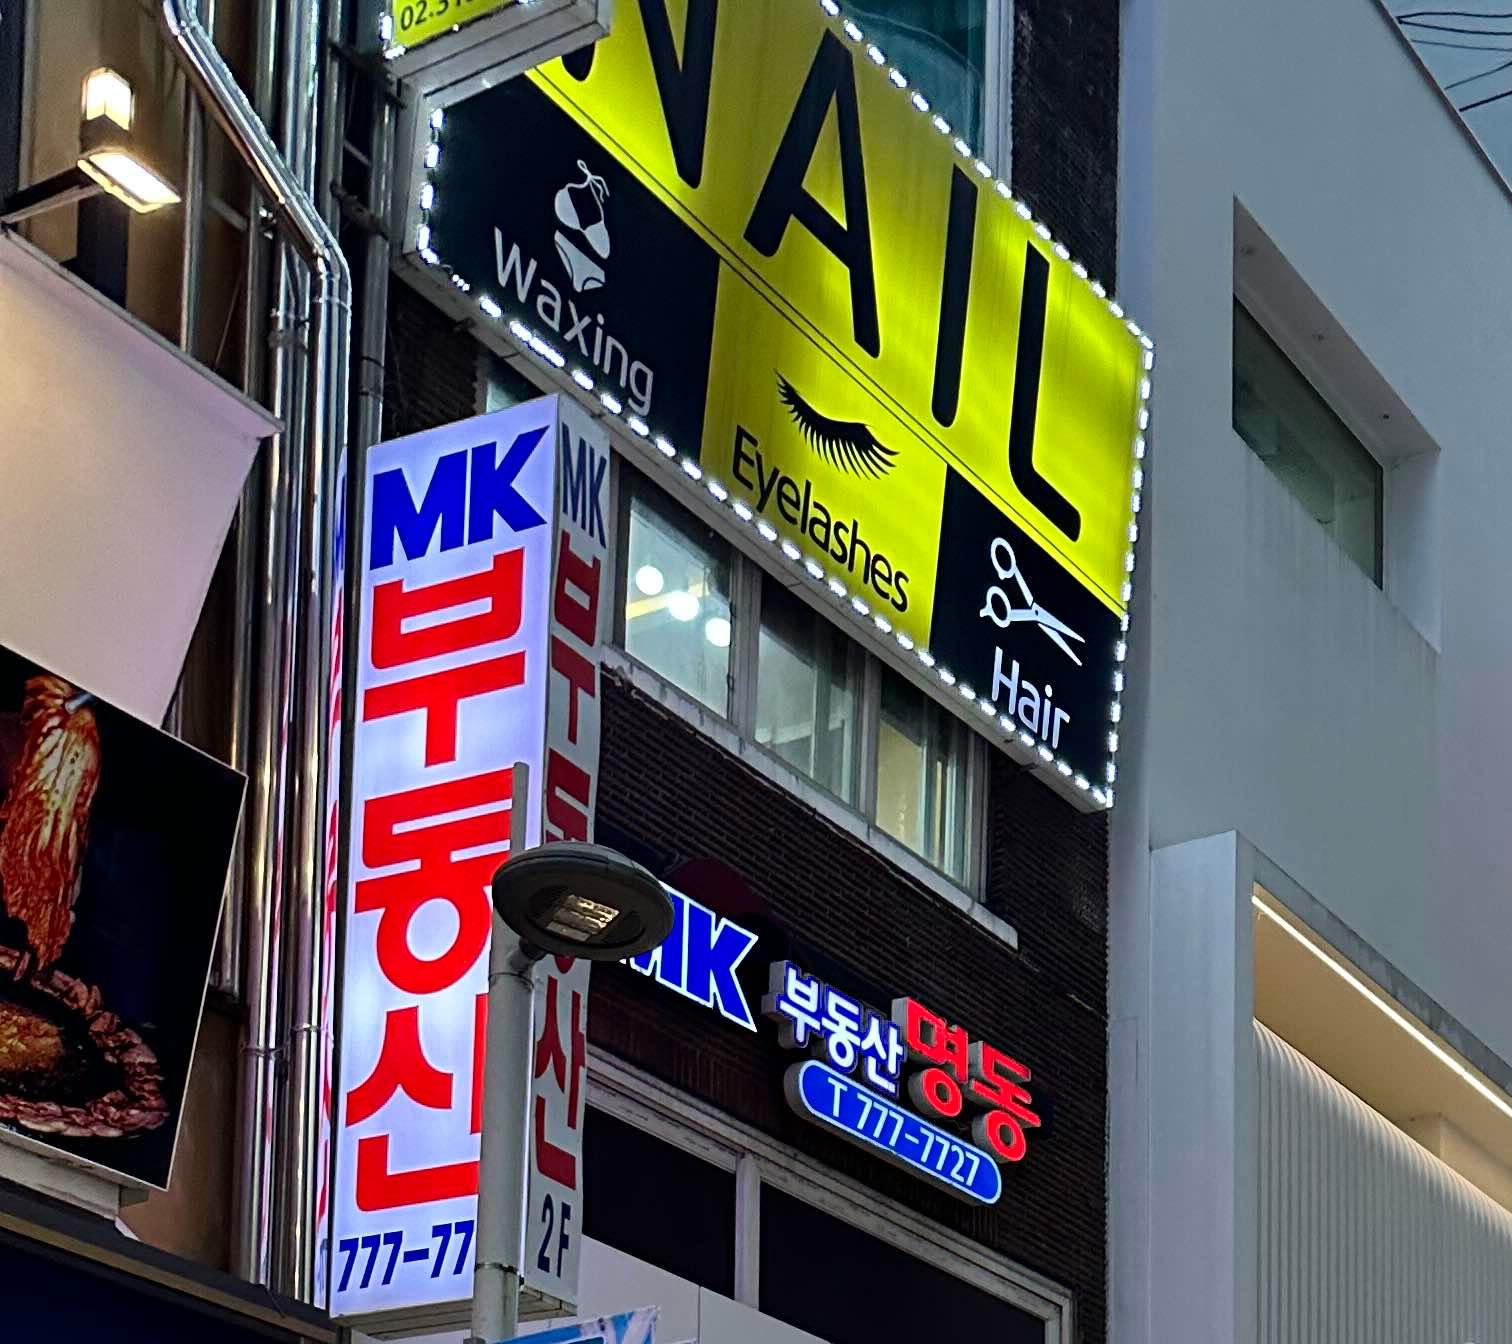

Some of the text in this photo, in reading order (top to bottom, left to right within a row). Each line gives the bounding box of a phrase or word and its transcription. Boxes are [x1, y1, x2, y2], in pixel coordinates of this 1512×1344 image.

[494, 228, 654, 420] Waxing
[370, 426, 551, 571] MK
[561, 422, 608, 550] MK
[731, 425, 910, 613] Eyelashes
[991, 647, 1071, 751] Hair
[778, 966, 906, 1094] 부동산
[905, 996, 1041, 1162] 명동
[827, 1076, 981, 1187] T 777-7727
[337, 1220, 475, 1293] 777-77
[539, 1192, 571, 1280] 2F
